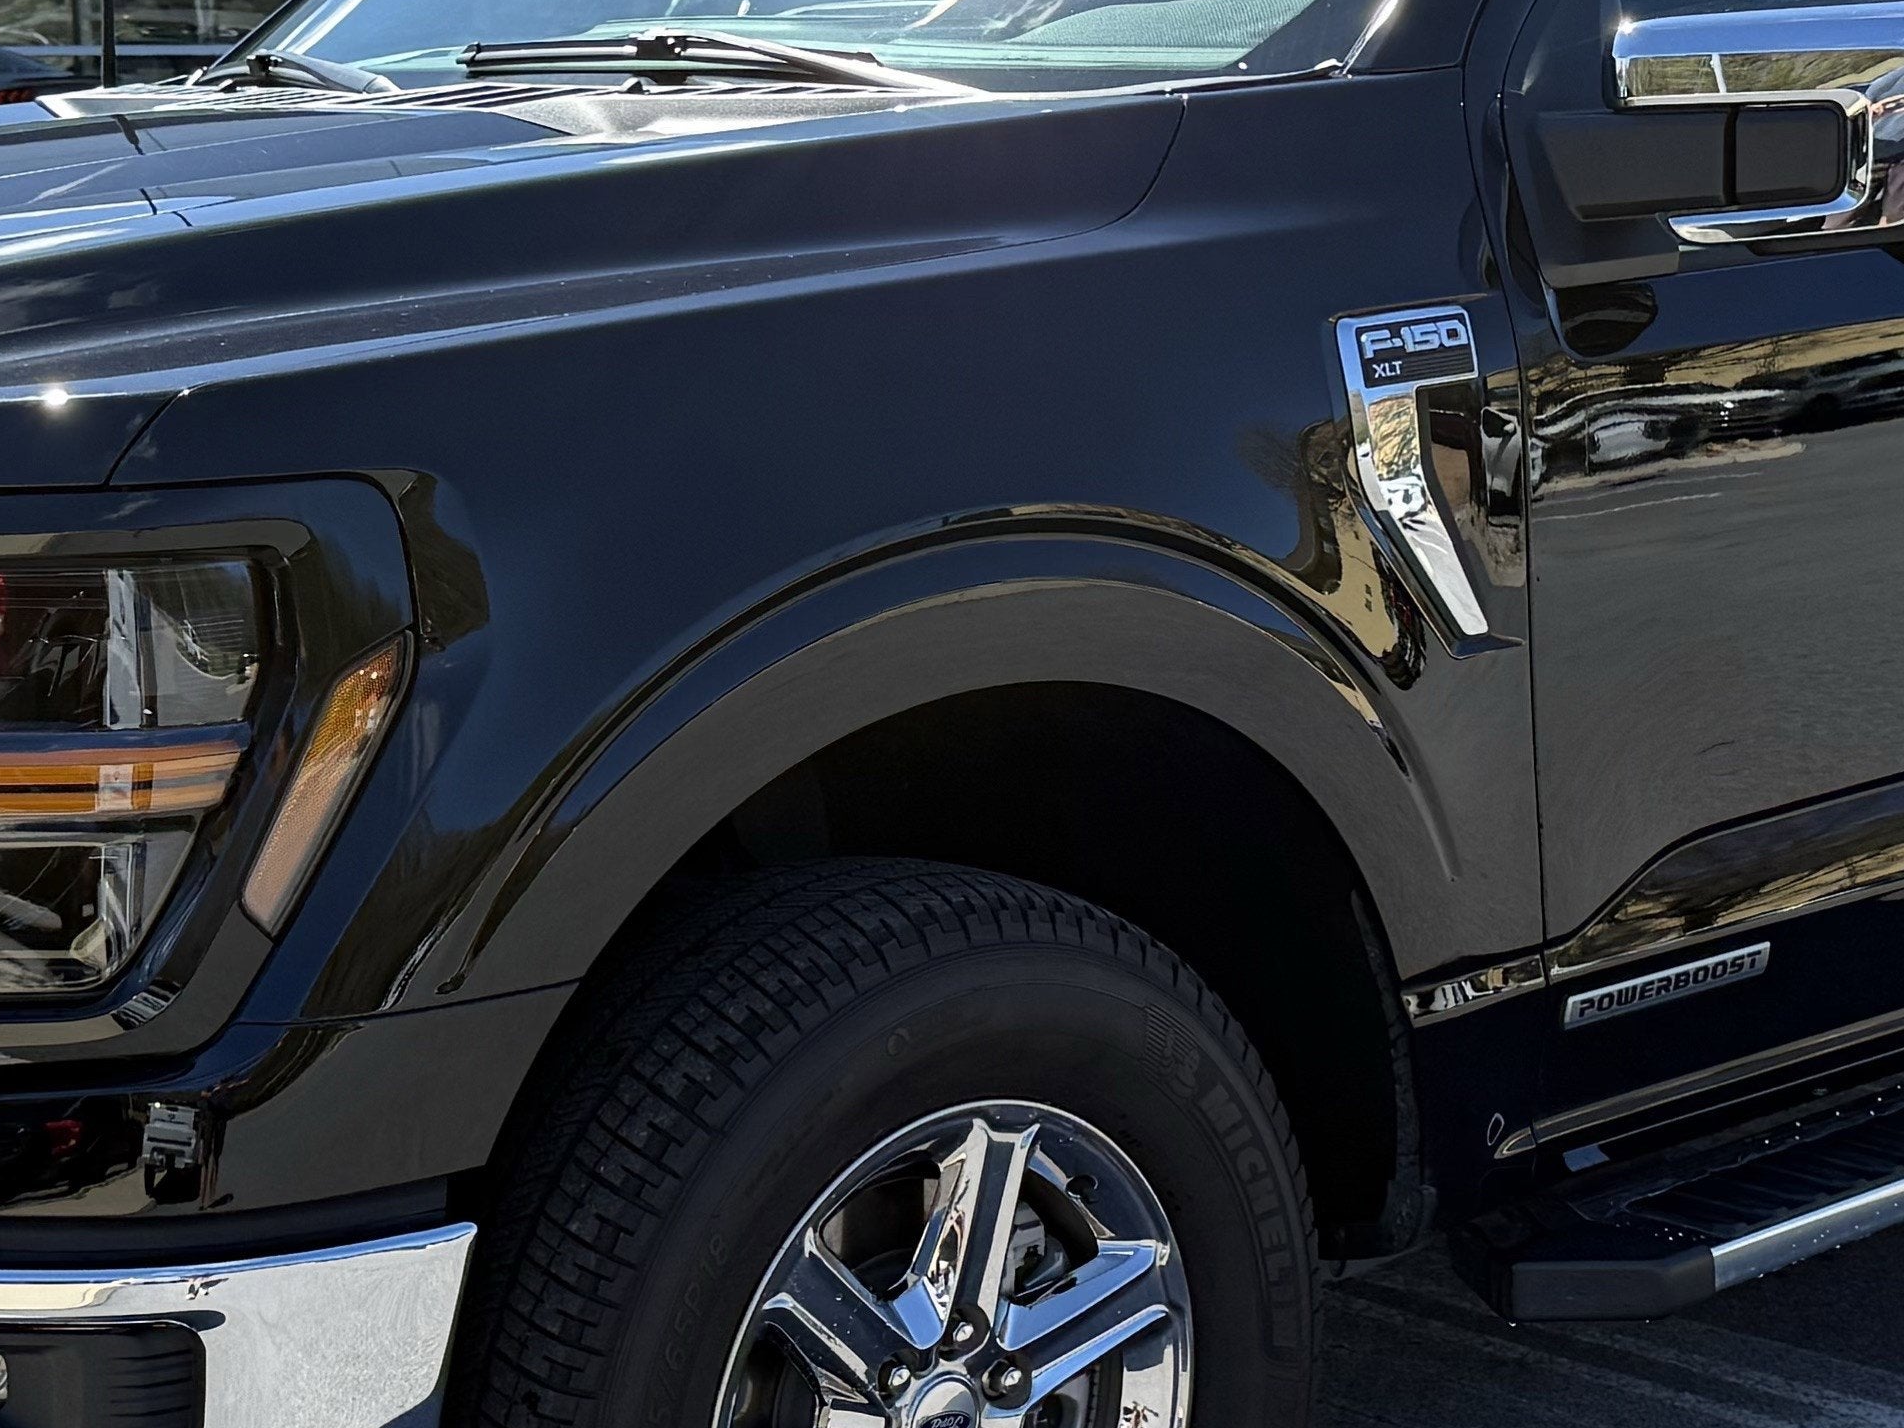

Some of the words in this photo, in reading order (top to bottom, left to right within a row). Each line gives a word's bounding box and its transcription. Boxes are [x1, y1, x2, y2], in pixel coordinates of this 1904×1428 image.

[1360, 319, 1469, 359] F-150
[1372, 360, 1402, 378] XLT
[1578, 950, 1762, 1018] POWERBOOST
